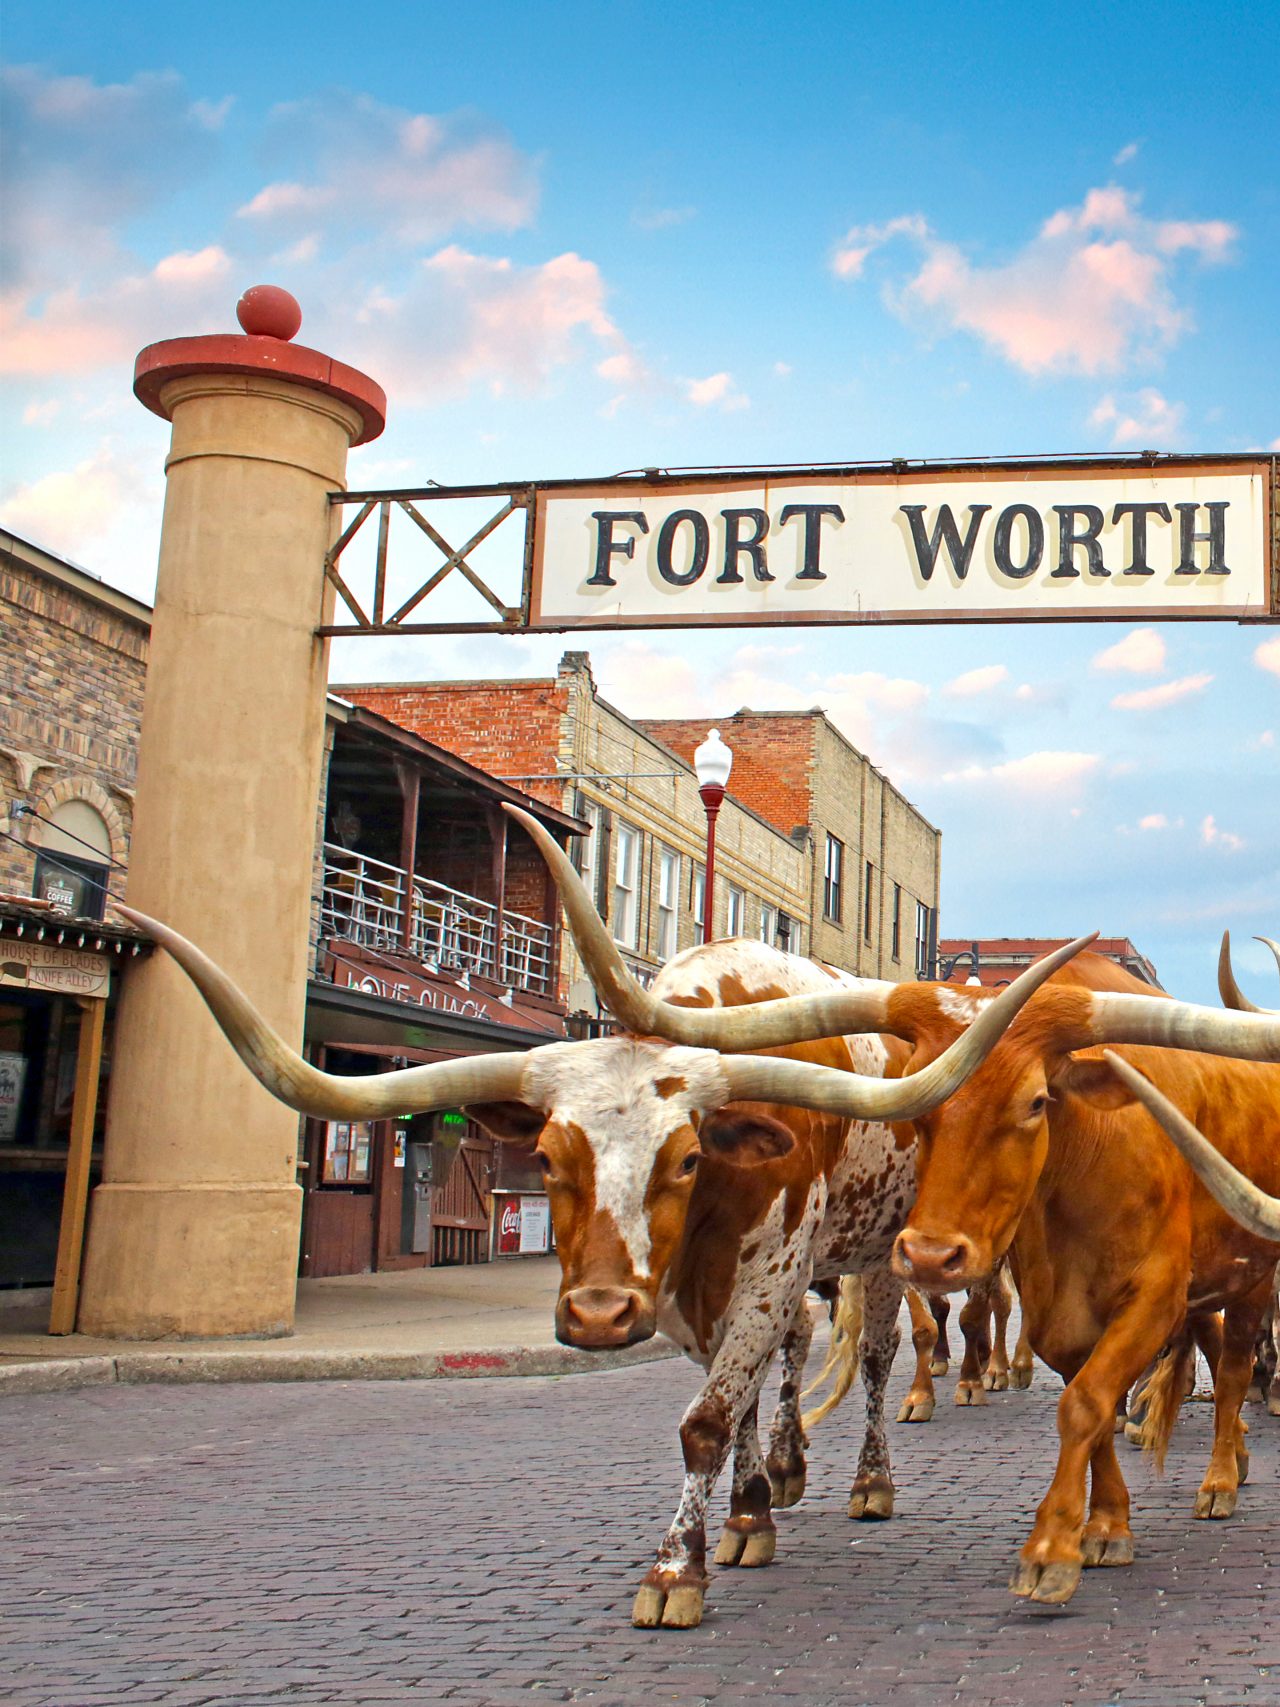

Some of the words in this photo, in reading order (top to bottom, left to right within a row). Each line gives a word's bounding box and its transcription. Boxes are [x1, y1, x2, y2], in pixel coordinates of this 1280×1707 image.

[586, 503, 846, 586] FORT
[899, 501, 1233, 581] WORTH
[47, 892, 73, 904] COFFEE
[1, 942, 39, 962] HOUSE
[43, 949, 58, 965] OF
[62, 951, 104, 971] BLADES
[35, 967, 64, 985] KNIFE
[65, 972, 94, 988] ALLEY
